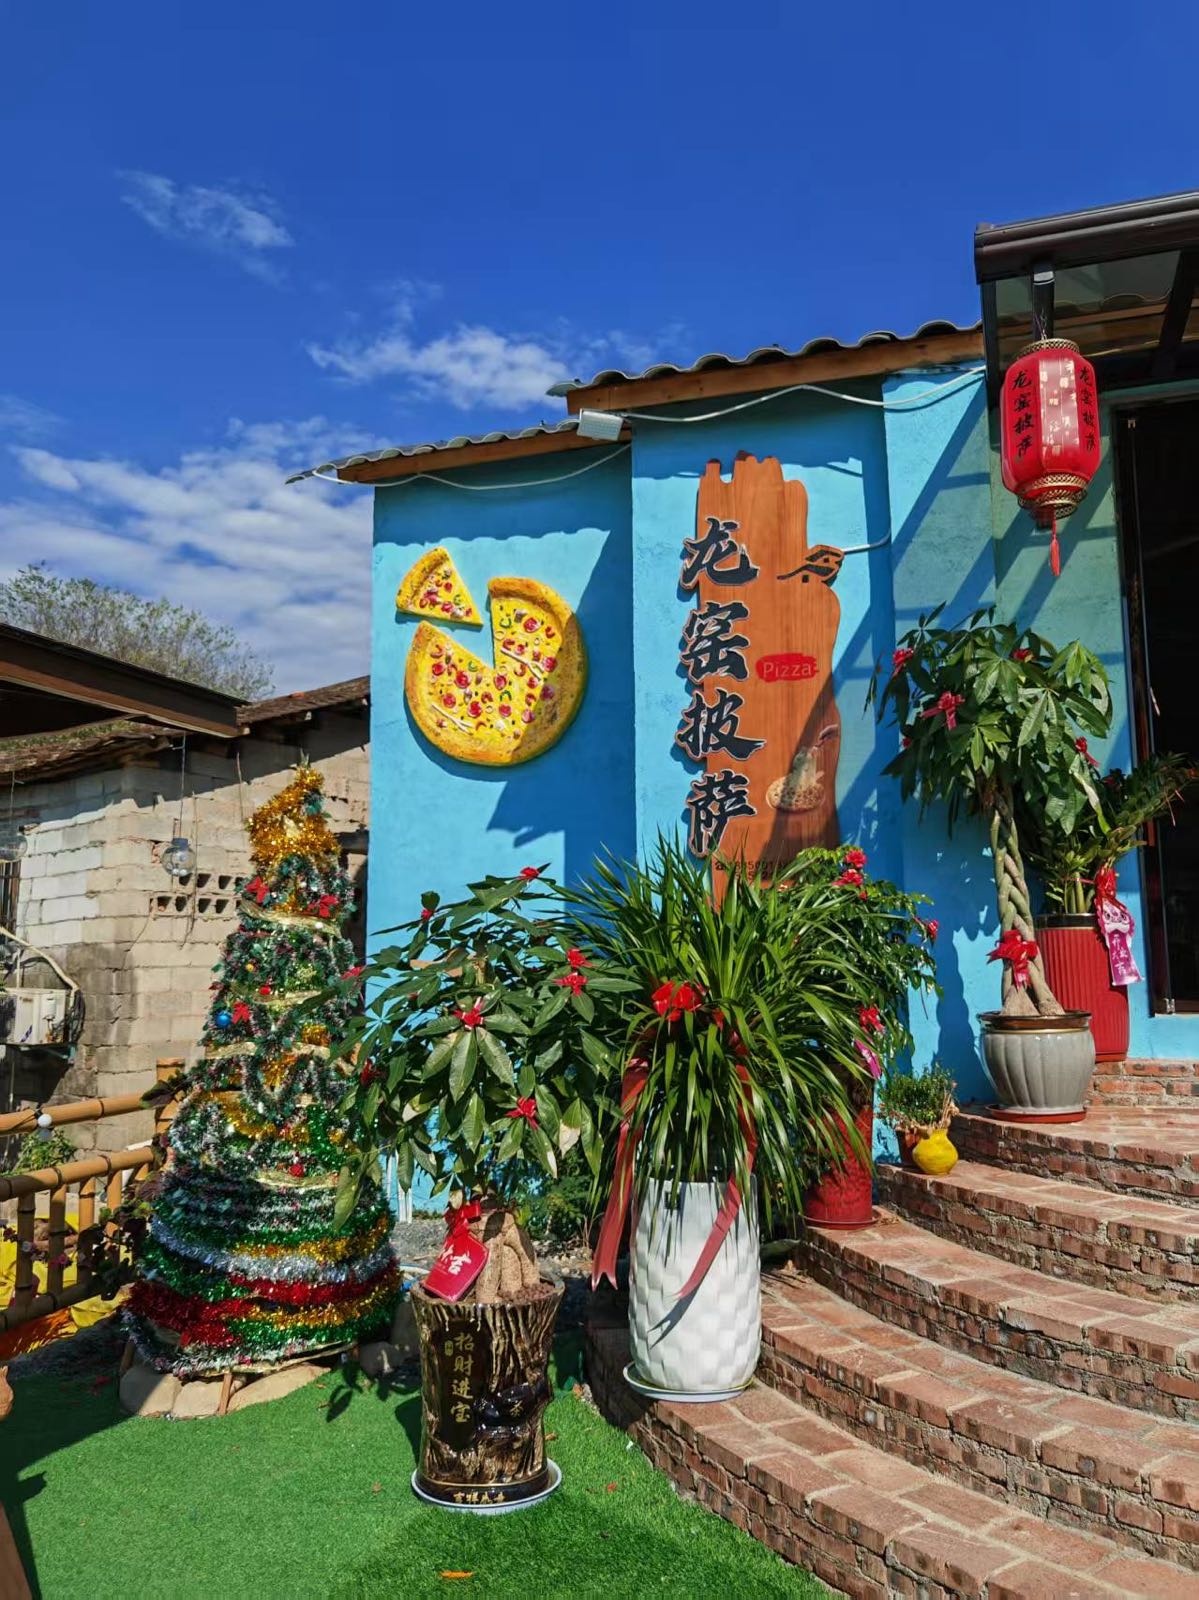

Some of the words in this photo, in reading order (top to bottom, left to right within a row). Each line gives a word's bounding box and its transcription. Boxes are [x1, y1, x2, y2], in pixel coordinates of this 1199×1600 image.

[763, 661, 811, 678] Pizza
[451, 1332, 475, 1423] 招财进宝
